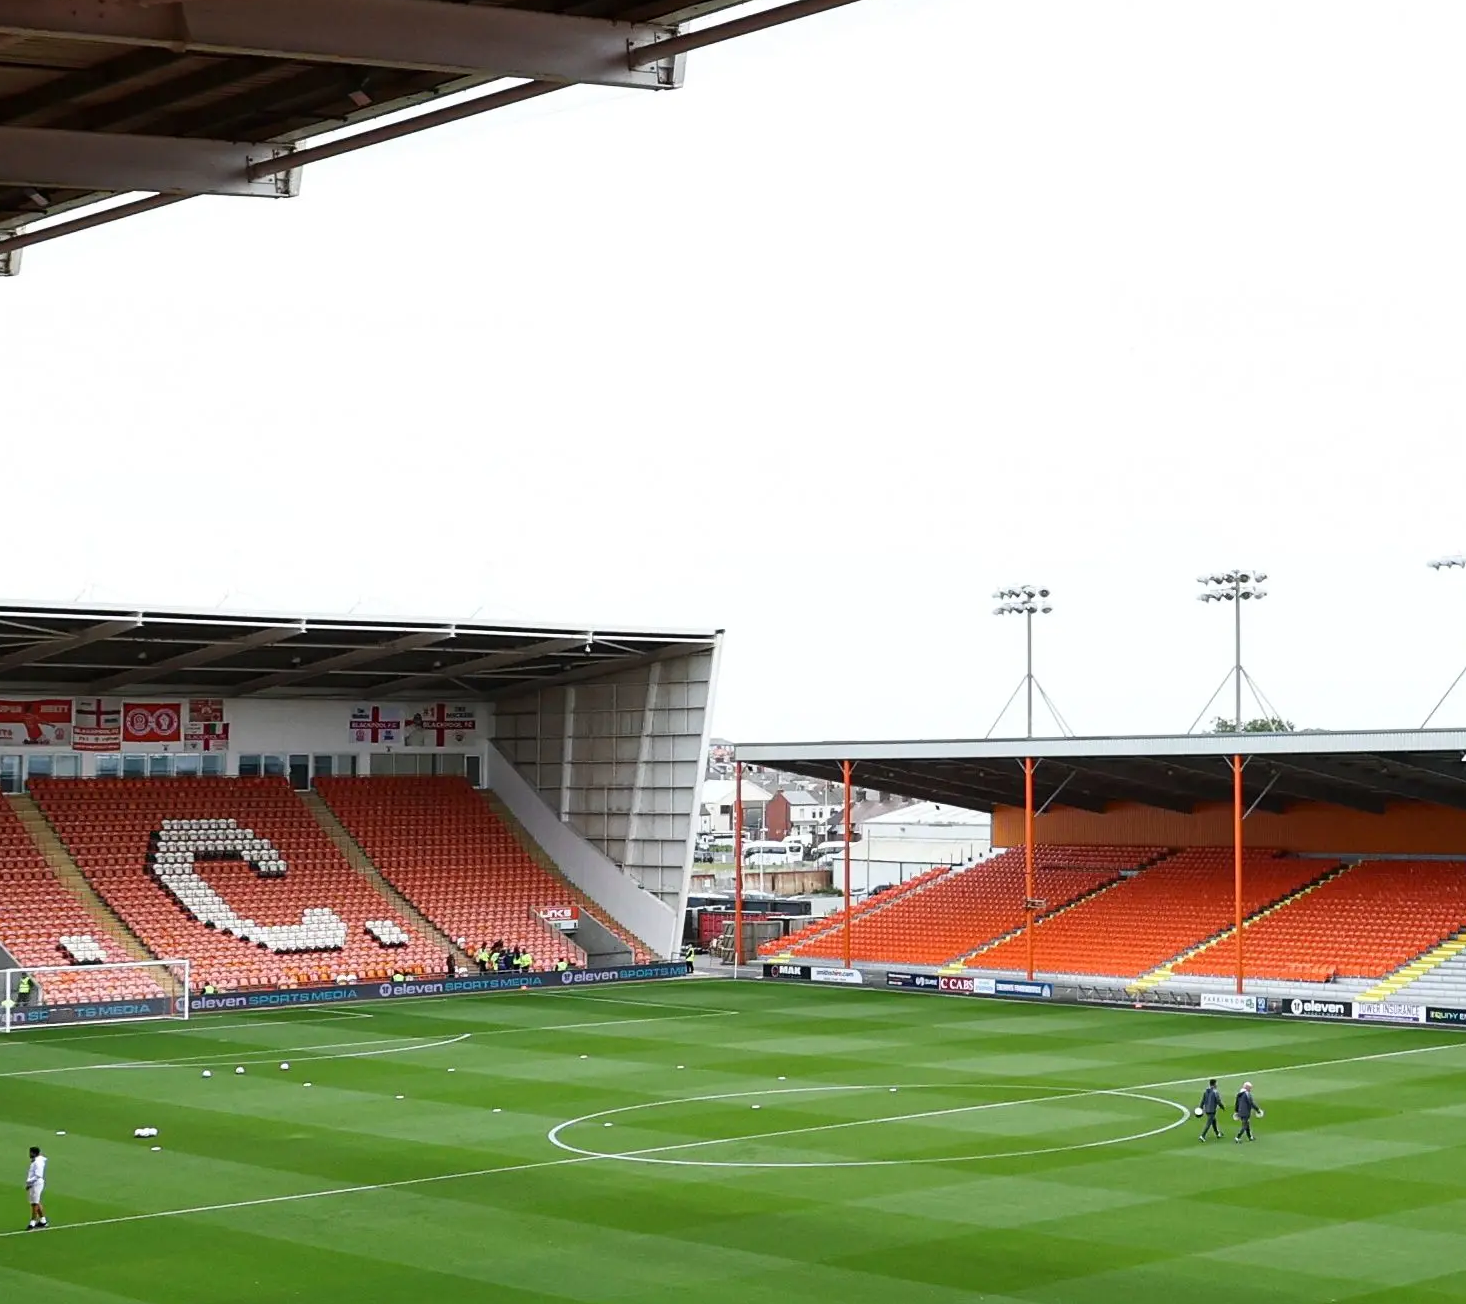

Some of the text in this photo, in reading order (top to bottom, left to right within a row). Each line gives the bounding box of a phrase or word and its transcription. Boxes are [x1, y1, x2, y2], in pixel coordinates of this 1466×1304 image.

[574, 966, 667, 983] eleven SPORTS
[779, 966, 801, 976] MAK
[394, 974, 542, 996] eleven SPORTS MEDIA
[950, 978, 974, 991] CABS
[191, 987, 358, 1009] eleven SPORTS MEDIA
[99, 1004, 151, 1016] MEDIA
[1304, 1001, 1344, 1014] eleven
